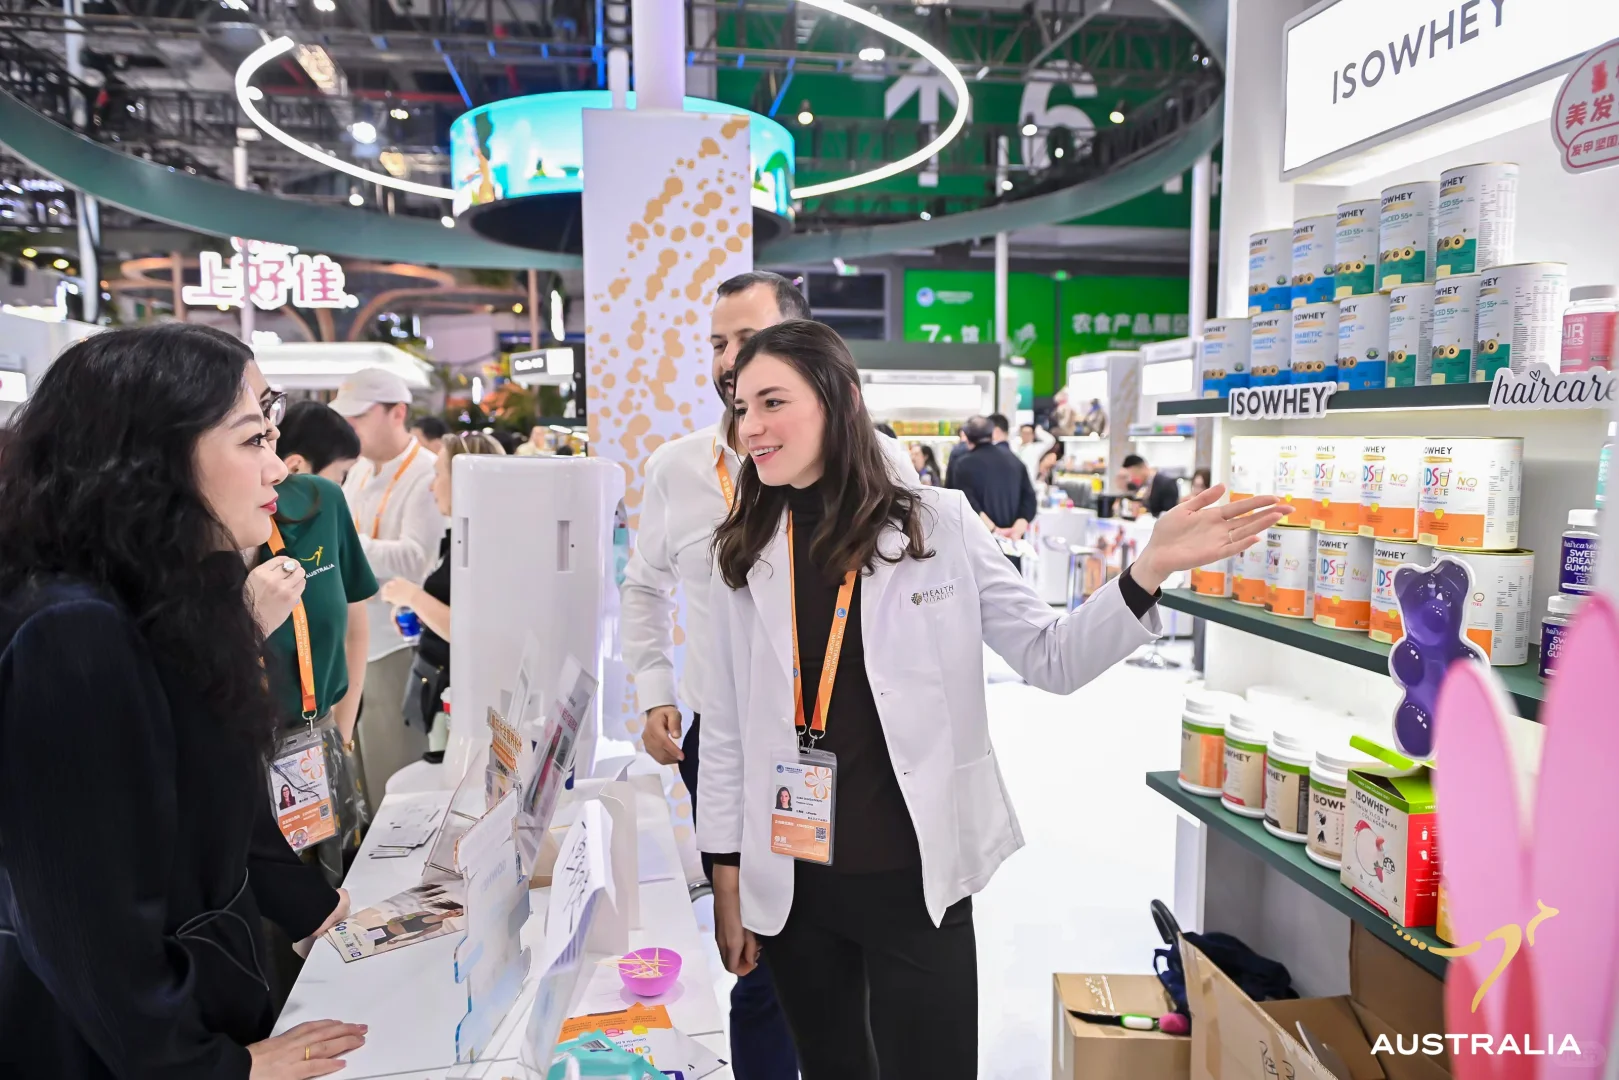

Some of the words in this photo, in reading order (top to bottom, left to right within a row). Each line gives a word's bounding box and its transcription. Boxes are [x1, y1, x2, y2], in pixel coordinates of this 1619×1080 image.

[1332, 0, 1507, 104] ISOWHEY
[1566, 93, 1619, 129] 美发
[1571, 134, 1619, 157] 发甲坚固
[1440, 175, 1465, 189] WHEY
[1231, 386, 1326, 416] ISOWHEY
[1375, 548, 1406, 560] SOWHEY
[1569, 549, 1596, 558] SWEE
[1565, 564, 1594, 573] GUMM
[922, 584, 954, 598] HEALTH
[1355, 789, 1390, 817] ISOWHEY
